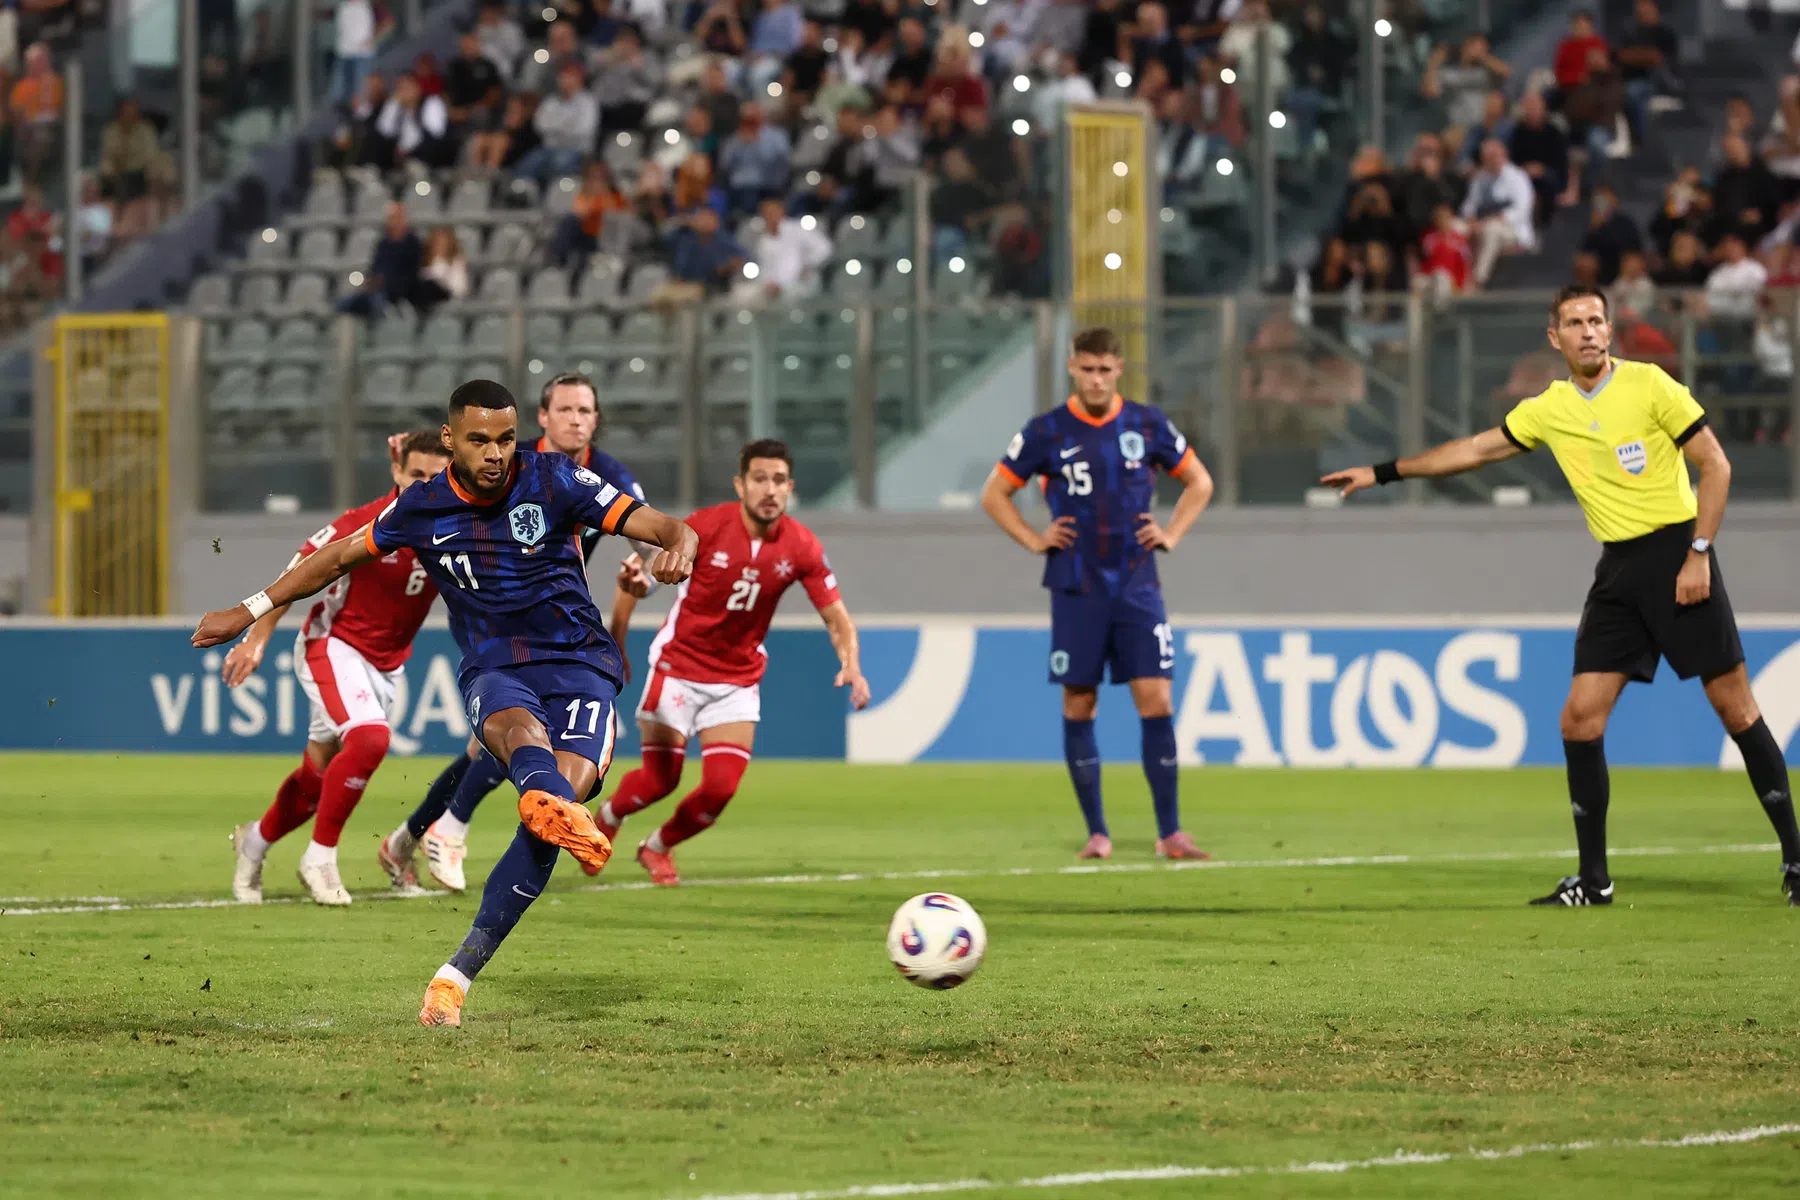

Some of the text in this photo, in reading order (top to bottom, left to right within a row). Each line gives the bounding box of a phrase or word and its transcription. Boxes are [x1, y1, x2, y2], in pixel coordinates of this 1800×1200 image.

[1618, 443, 1642, 456] FIFA
[1061, 461, 1094, 496] 15
[405, 569, 429, 596] 6
[439, 552, 479, 590] 11
[726, 579, 761, 612] 21
[564, 698, 601, 735] 11
